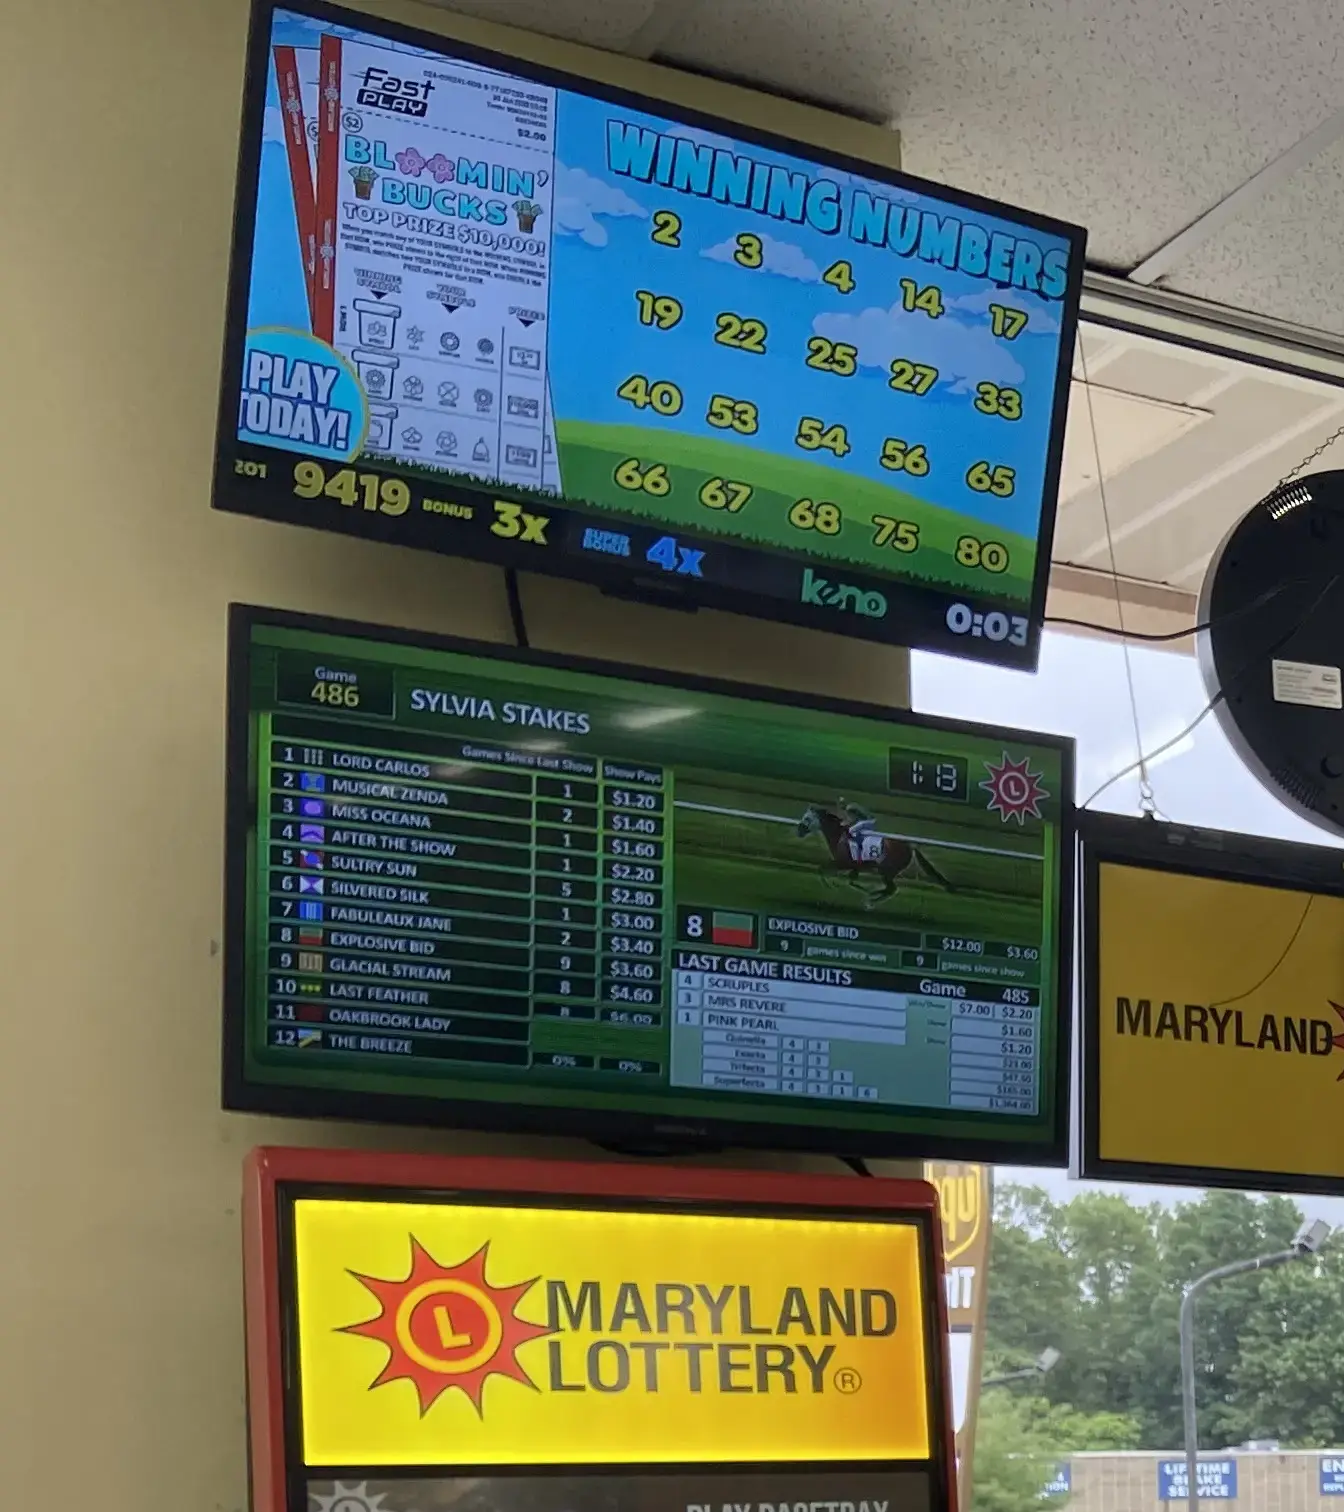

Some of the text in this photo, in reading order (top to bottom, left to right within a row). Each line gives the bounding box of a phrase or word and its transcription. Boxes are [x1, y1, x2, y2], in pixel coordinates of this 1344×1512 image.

[363, 67, 435, 99] Fast
[362, 92, 423, 114] PLAY
[382, 177, 507, 225] BUCKS
[605, 119, 1069, 299] WINNING NUMBERS
[342, 202, 388, 224] TOP
[392, 212, 454, 239] PRIZE
[457, 224, 545, 257] $10,000!
[651, 210, 681, 248] 2
[733, 233, 763, 269] 3
[822, 260, 855, 294] 4
[635, 291, 682, 328] 19
[899, 279, 943, 318] 14
[714, 313, 767, 354] 22
[989, 304, 1028, 339] 17
[806, 337, 857, 376] 25
[248, 349, 340, 404] PLAY
[889, 361, 937, 395] 27
[617, 375, 683, 416] 40
[974, 383, 1022, 420] 33
[707, 396, 758, 435] 53
[795, 418, 850, 456] 54
[880, 439, 930, 477] 56
[293, 461, 411, 516] 9419
[614, 459, 670, 496] 66
[700, 478, 752, 514] 67
[965, 462, 1016, 497] 65
[490, 500, 549, 545] 3x
[789, 499, 842, 536] 68
[872, 516, 920, 552] 75
[646, 536, 706, 577] 4x
[955, 536, 1009, 573] 80
[800, 569, 888, 618] keno
[945, 604, 1029, 646] 0:03
[314, 666, 357, 683] Game
[311, 681, 359, 707] 486
[410, 688, 591, 734] SYLVIA STAKES
[333, 753, 430, 778] LORD CARLOS
[332, 804, 432, 829] MISS OCEANA
[679, 953, 852, 985] LAST GAME RESULTS
[1115, 996, 1333, 1056] MARYLAND
[546, 1281, 897, 1337] MARYLAND
[1168, 1485, 1229, 1497] SEVICE
